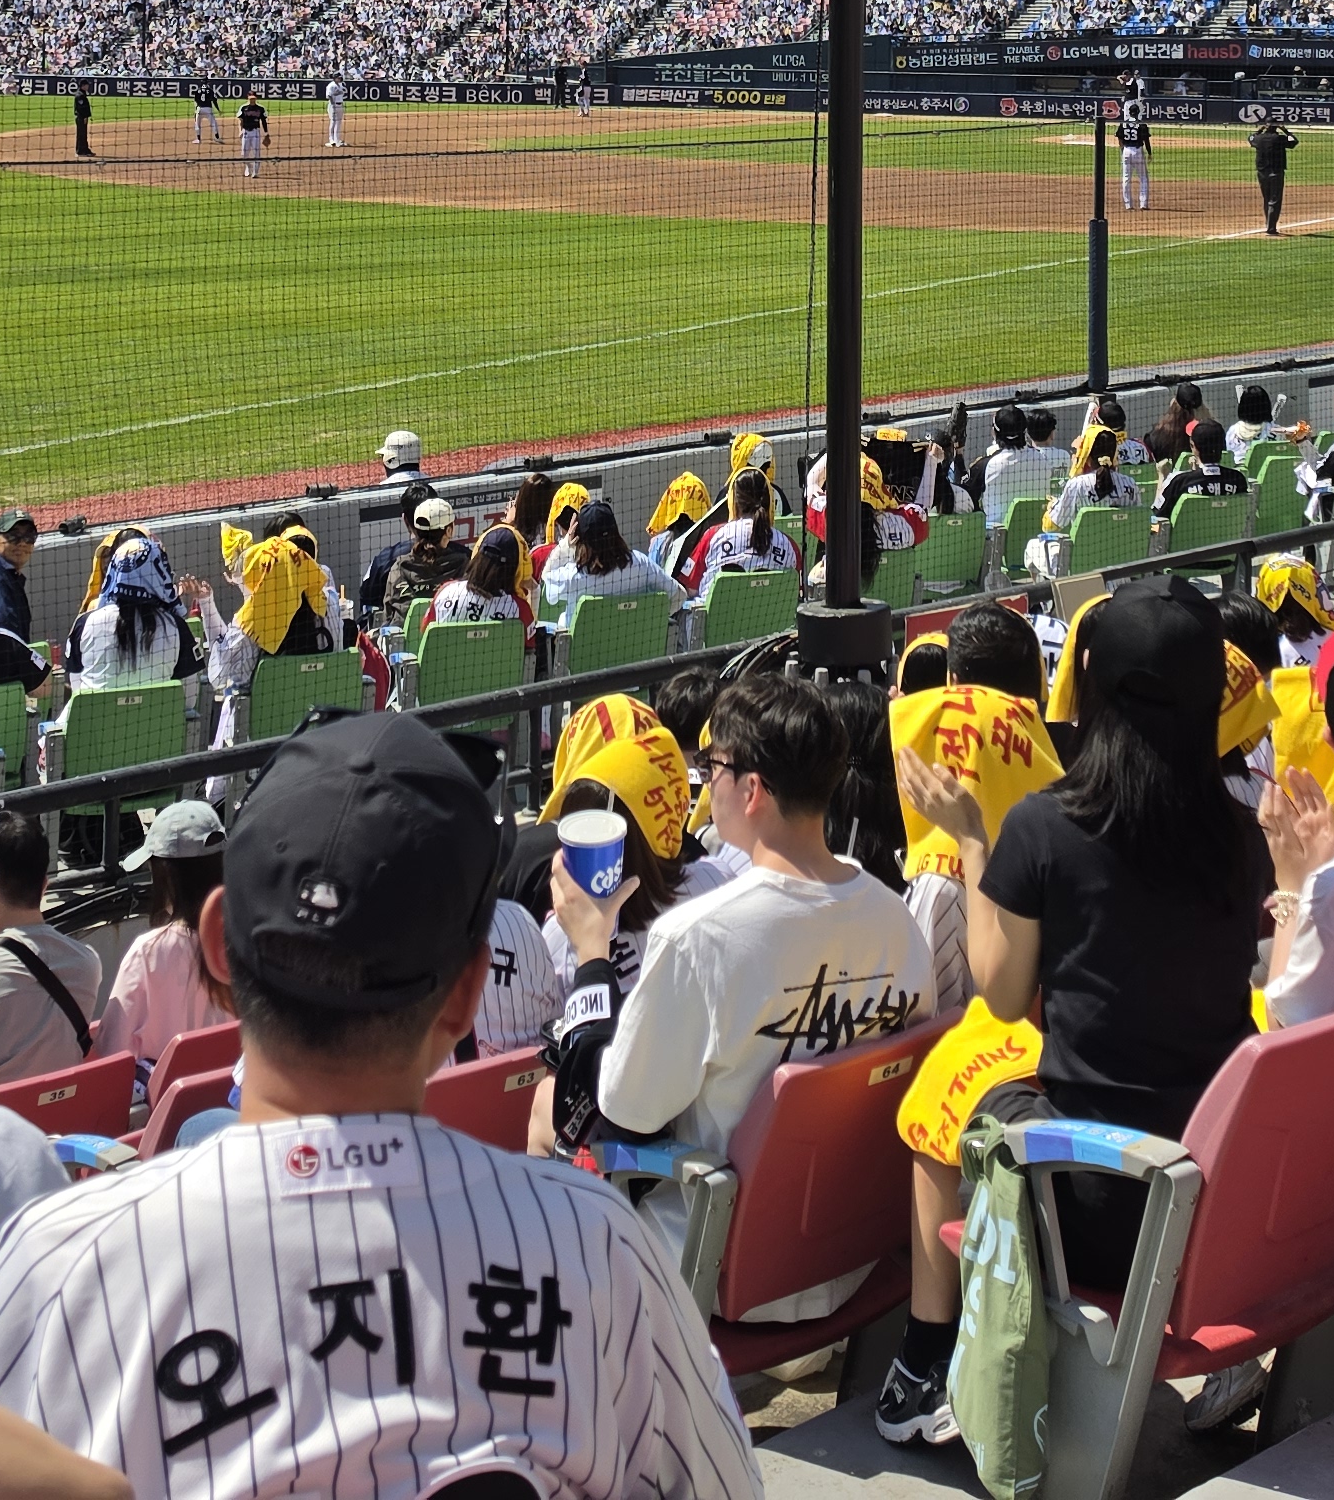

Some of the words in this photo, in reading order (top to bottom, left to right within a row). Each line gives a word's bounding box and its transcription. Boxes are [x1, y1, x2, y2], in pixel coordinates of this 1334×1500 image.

[1006, 45, 1041, 55] ENABLE
[1131, 44, 1185, 60] 대보건설
[1187, 44, 1242, 59] hausD
[908, 54, 999, 68] 농협안성팜랜드
[1003, 54, 1020, 63] THE
[1021, 54, 1045, 63] NEXT
[56, 77, 109, 97] Bêjo
[116, 79, 181, 98] 백조씽크
[188, 83, 243, 100] Bkjo
[250, 81, 317, 100] 백조씽크
[387, 84, 457, 103] 백조씽크
[534, 87, 610, 105] 백크
[712, 90, 762, 106] 5,000
[763, 93, 786, 105] 만원
[920, 97, 953, 112] 충주시
[1019, 99, 1099, 118] 육회바른연어
[1121, 102, 1204, 120] 바른연어
[1270, 105, 1331, 124] 금강주택
[1123, 128, 1138, 141] 53
[720, 540, 786, 566] 오틴
[516, 1071, 536, 1086] 63
[881, 1064, 901, 1078] 64
[48, 1089, 67, 1101] 35
[326, 1136, 405, 1172] LGU+
[155, 1263, 573, 1457] 오지환
